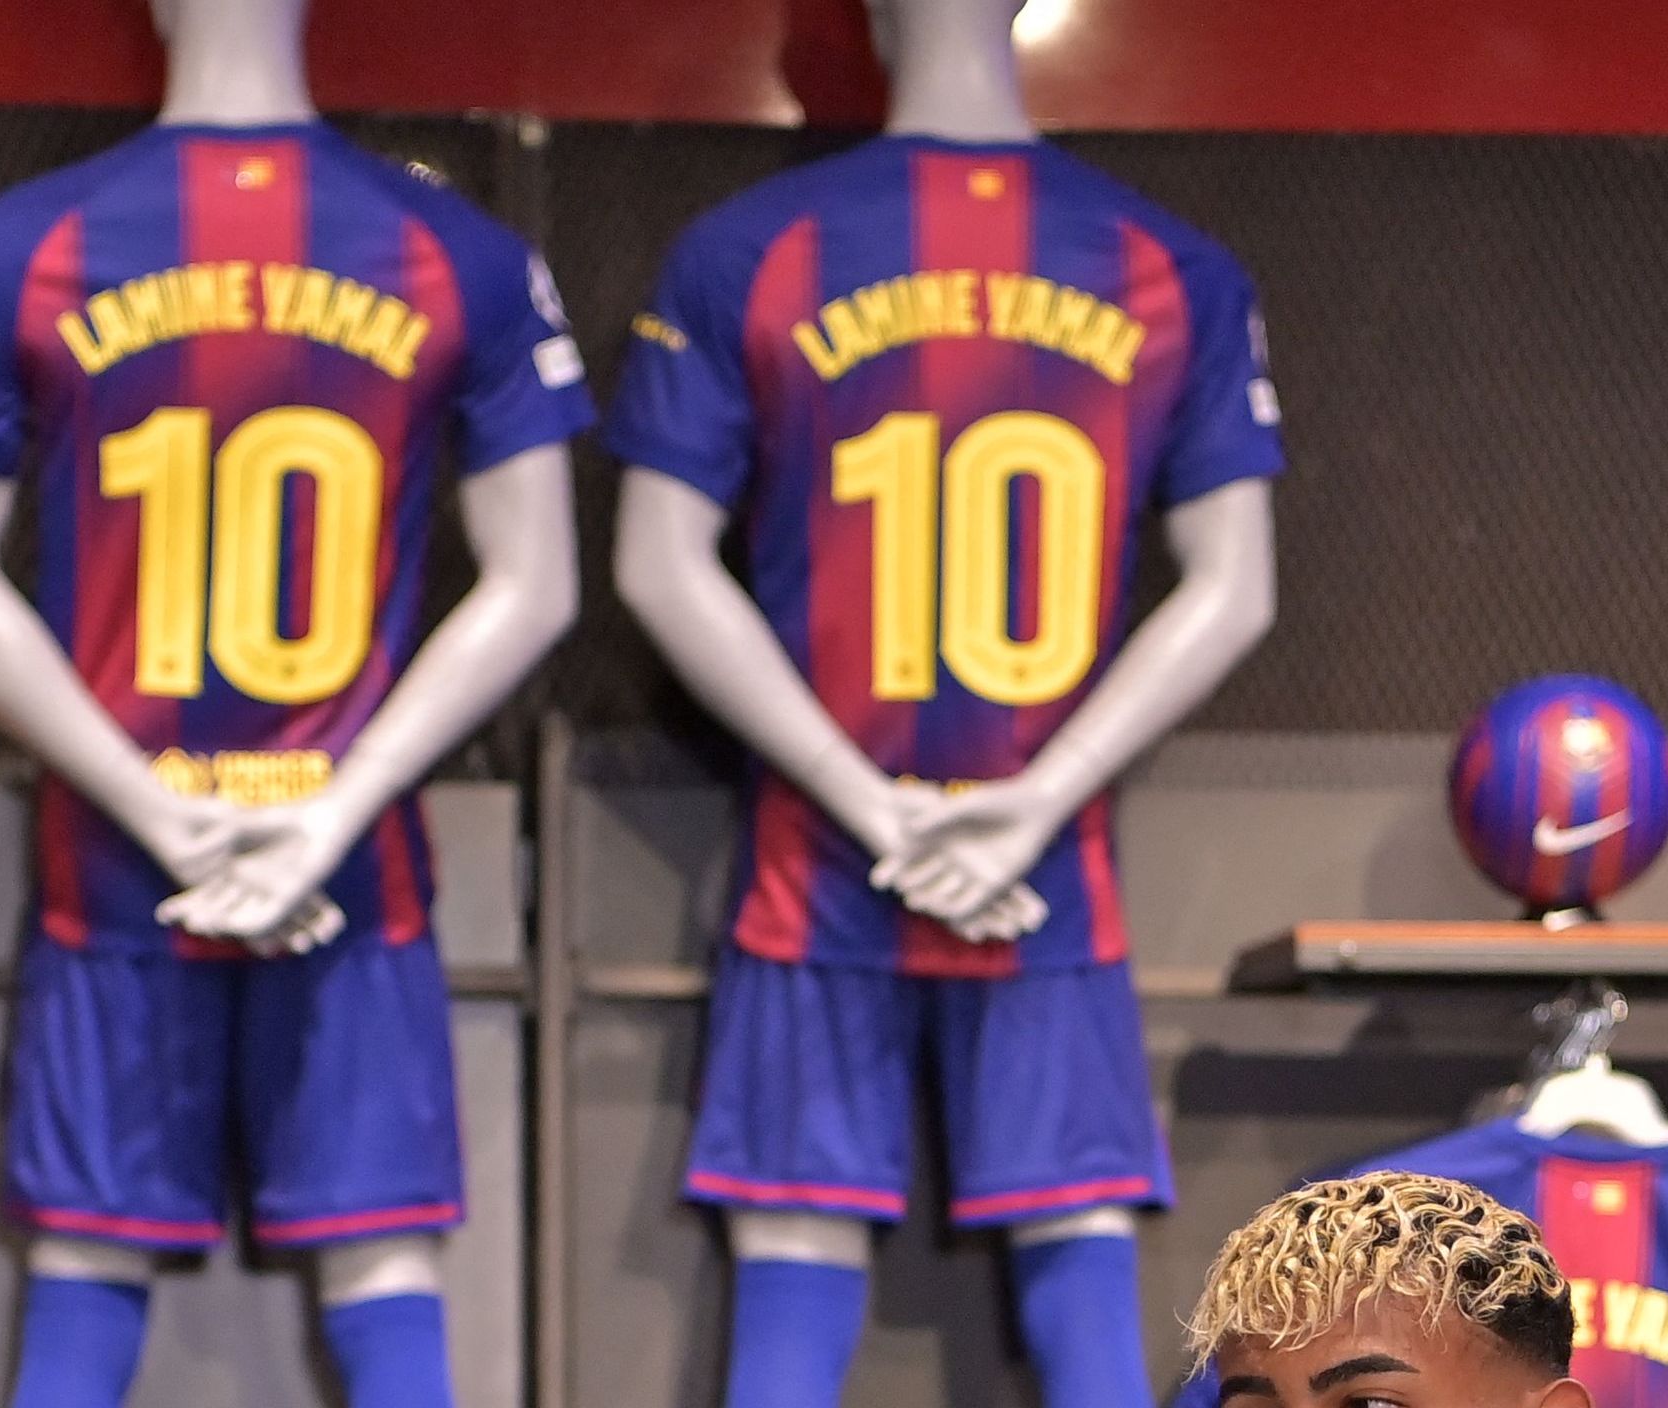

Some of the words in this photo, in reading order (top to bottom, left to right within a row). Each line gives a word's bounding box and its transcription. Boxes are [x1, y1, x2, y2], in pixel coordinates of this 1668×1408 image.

[56, 260, 255, 375] LAMINE
[261, 263, 434, 379] YAMAL
[790, 269, 980, 382] LAMINE
[986, 272, 1147, 385] YAMAL
[98, 406, 383, 704] 10
[830, 411, 1107, 706] 10
